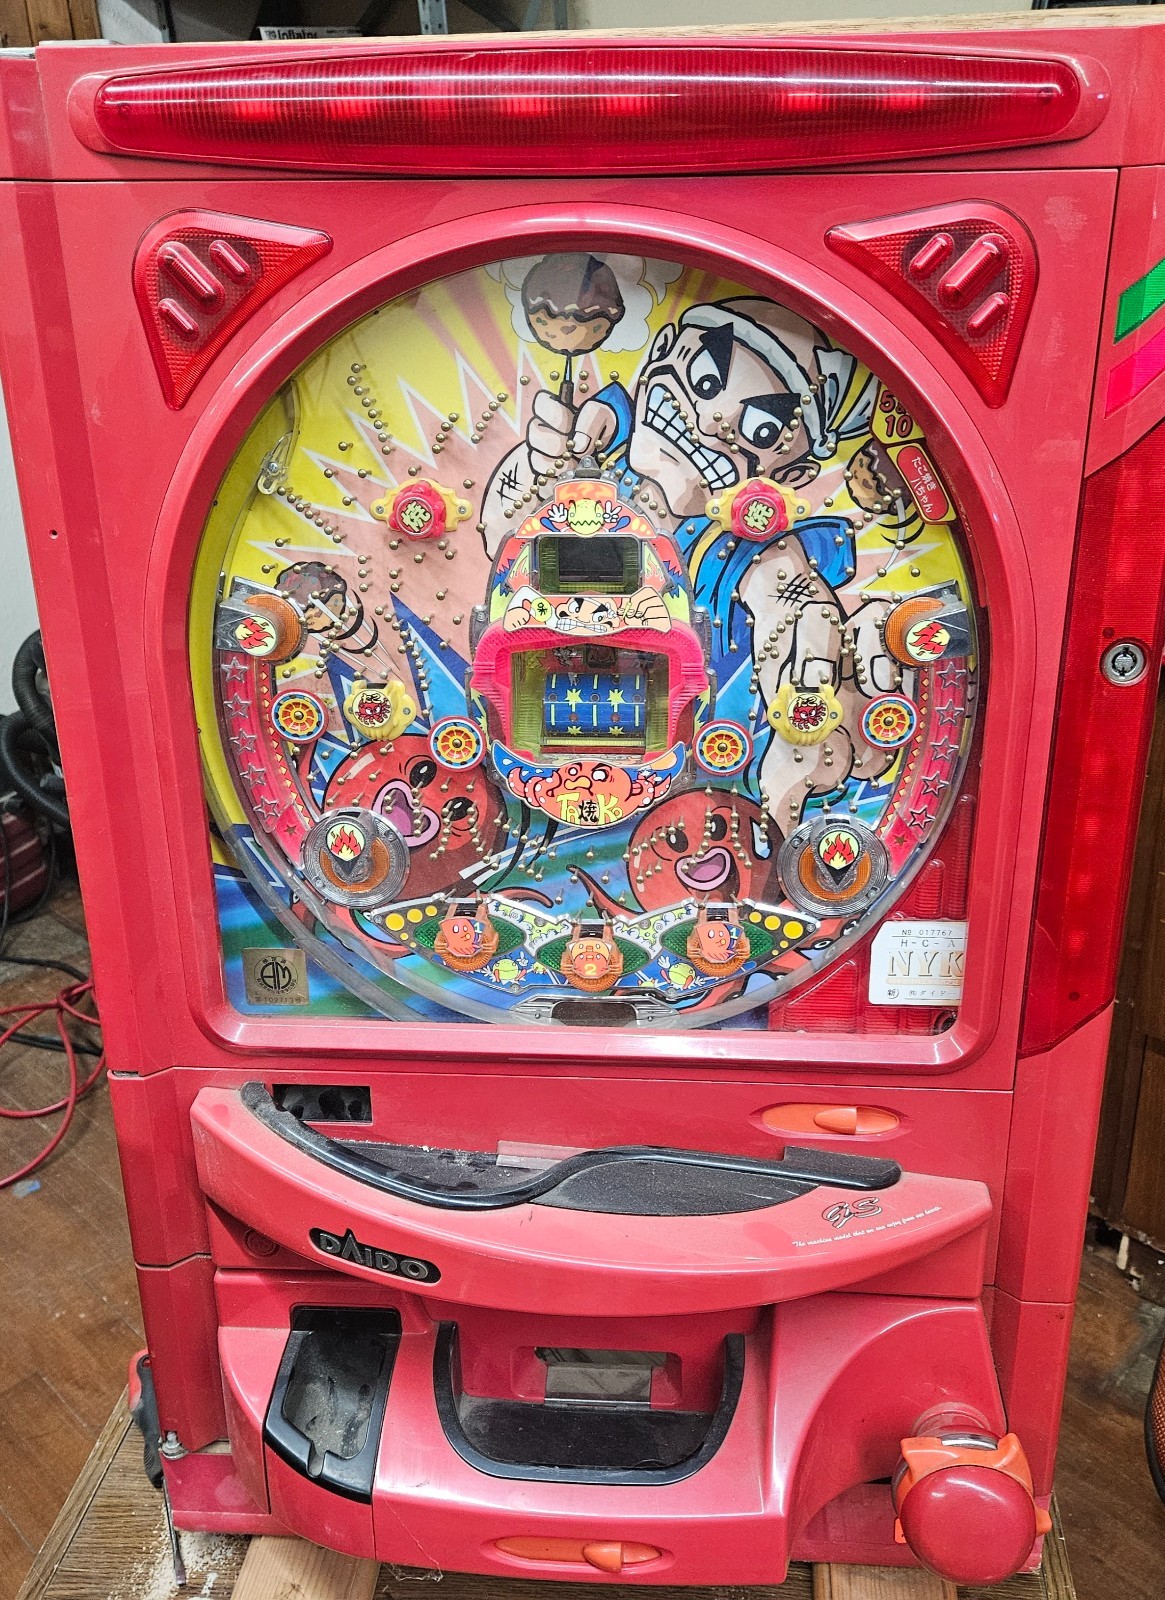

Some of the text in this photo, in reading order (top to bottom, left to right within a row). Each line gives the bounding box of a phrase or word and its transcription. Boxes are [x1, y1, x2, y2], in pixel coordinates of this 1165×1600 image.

[885, 414, 913, 438] 10
[918, 929, 953, 937] 017767
[584, 963, 597, 975] 2
[887, 950, 964, 978] NYK
[834, 1232, 851, 1241] model
[852, 1229, 865, 1237] that
[319, 1232, 429, 1280] DAIDO
